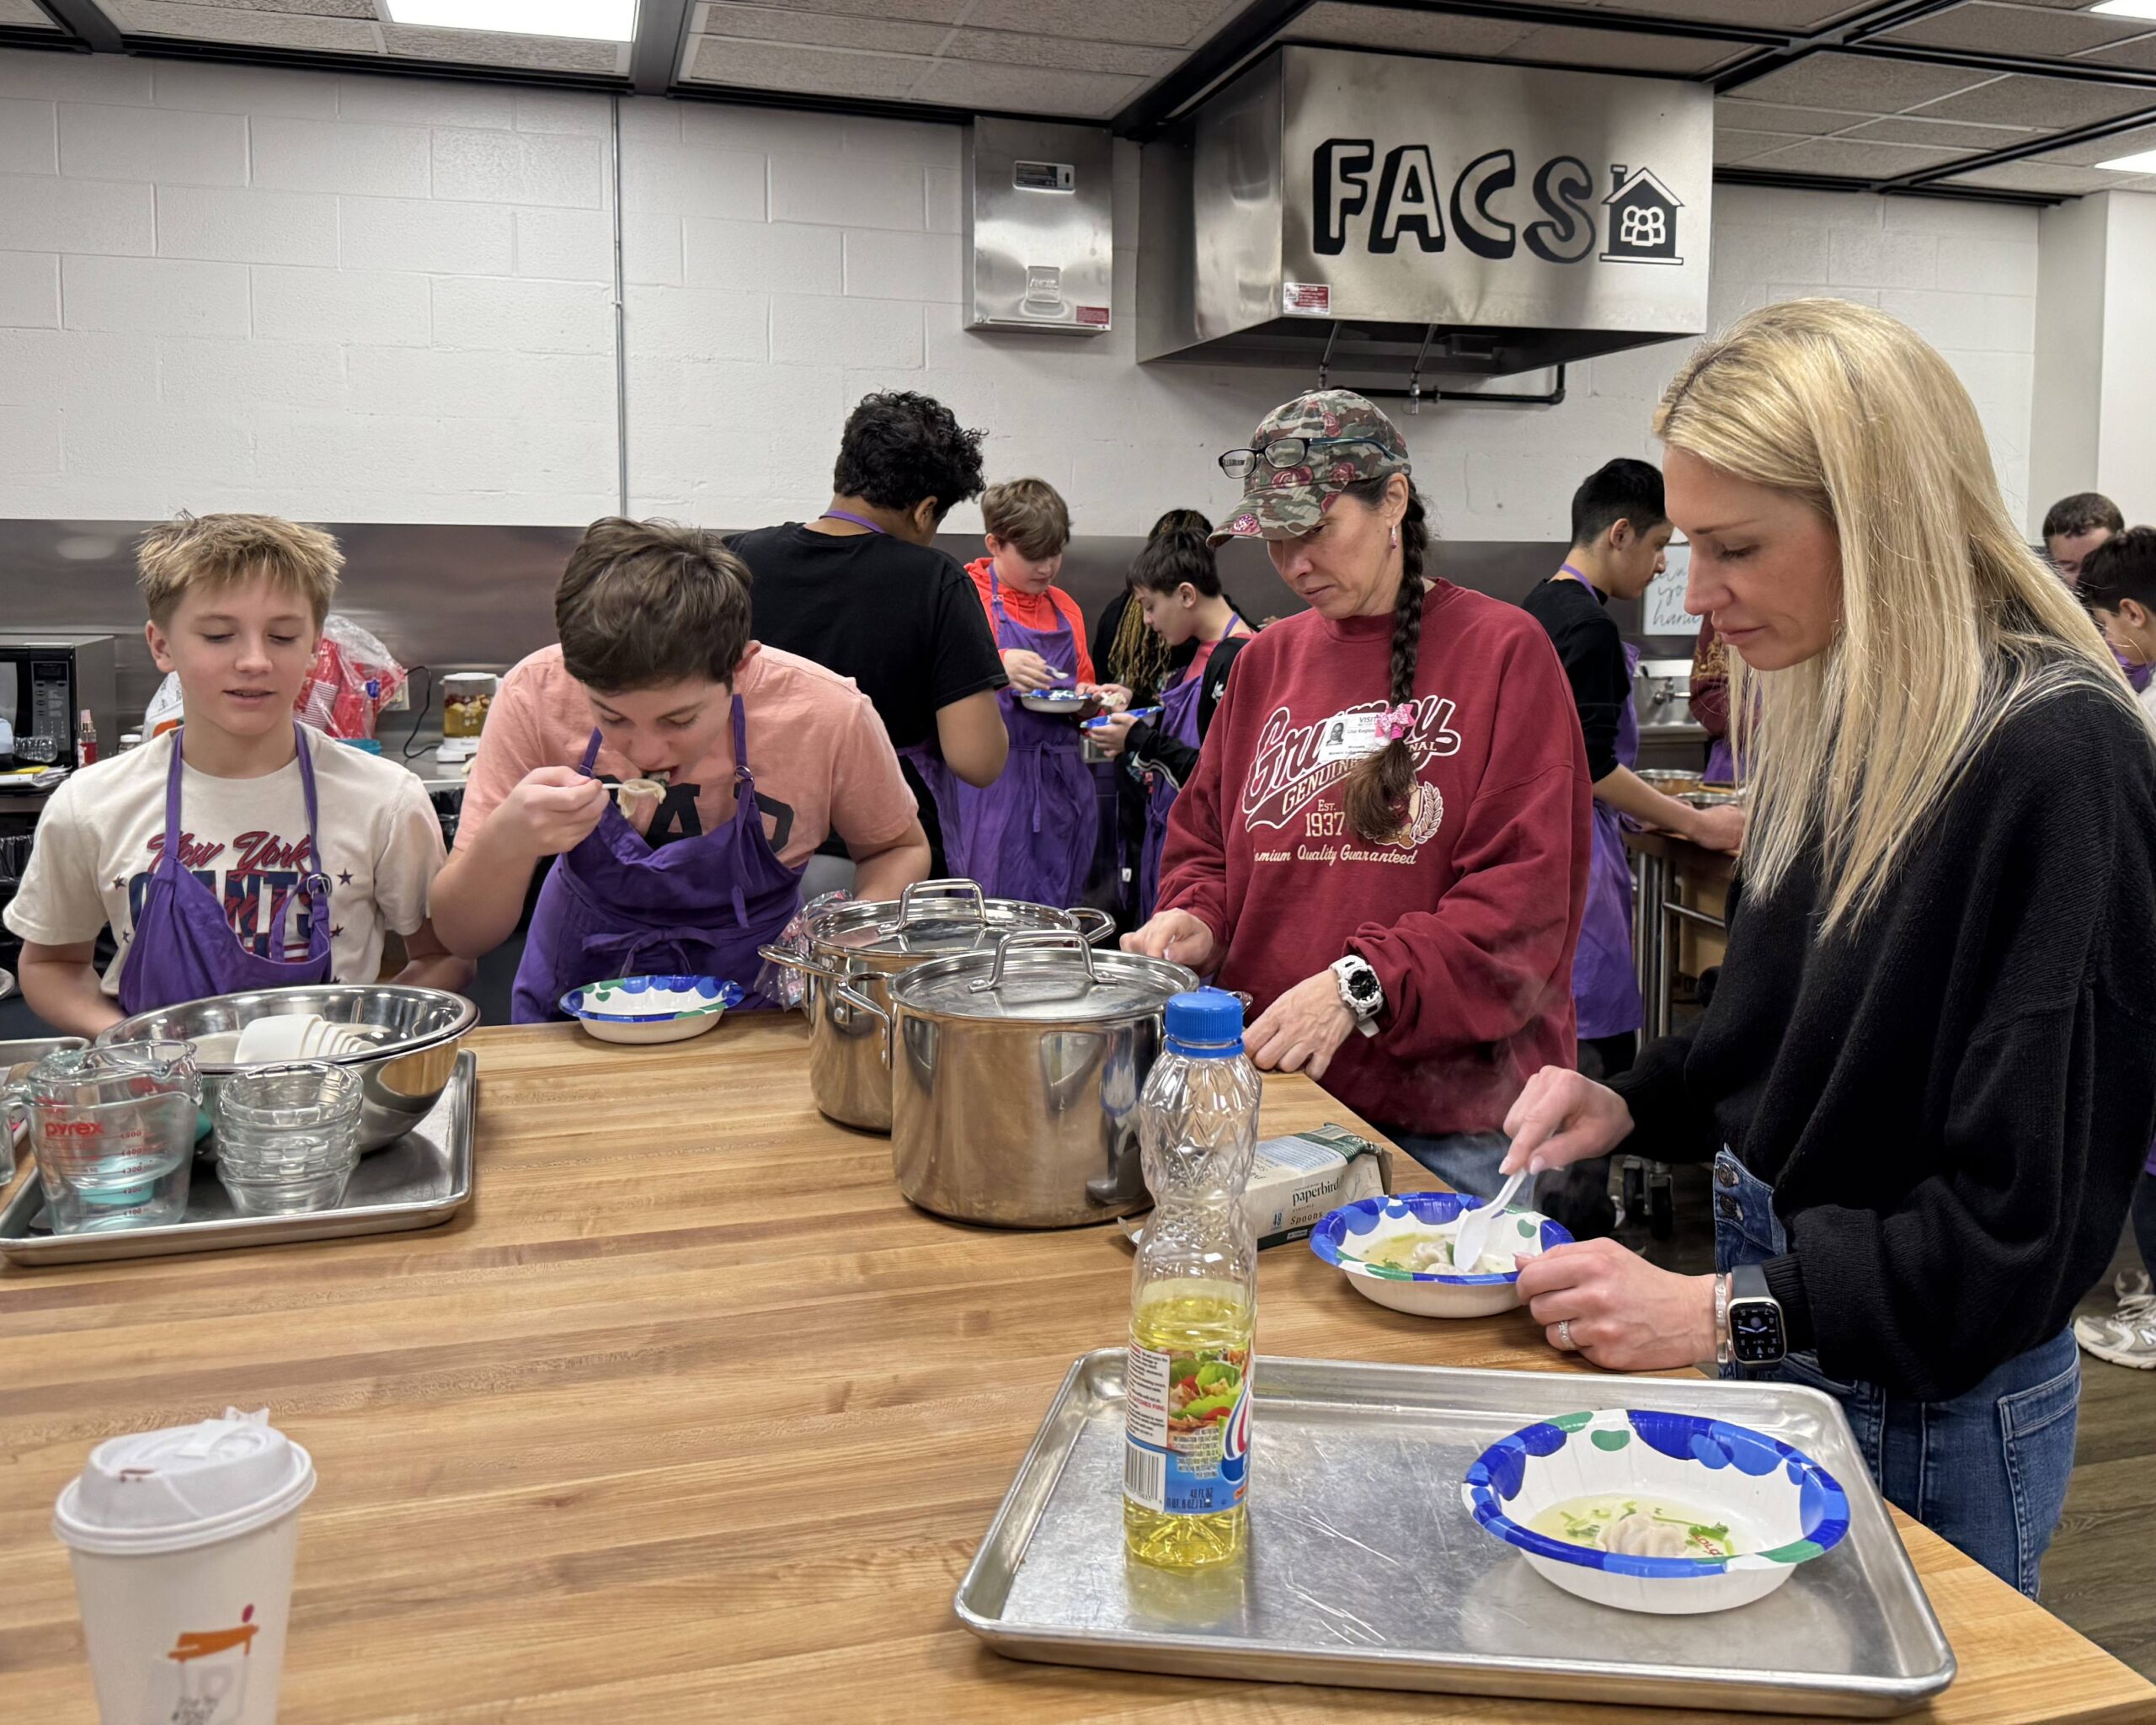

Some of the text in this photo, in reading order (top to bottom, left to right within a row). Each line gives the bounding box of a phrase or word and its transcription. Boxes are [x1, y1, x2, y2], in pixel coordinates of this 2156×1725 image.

[1312, 138, 1596, 263] FACS
[1305, 811, 1346, 837] 1937
[147, 830, 315, 882] New York
[1298, 844, 1337, 866] Quality
[1340, 844, 1419, 865] Guaranteed
[45, 1122, 104, 1138] pyrex
[1292, 1177, 1339, 1206] paperbird
[1290, 1211, 1323, 1226] Spoons
